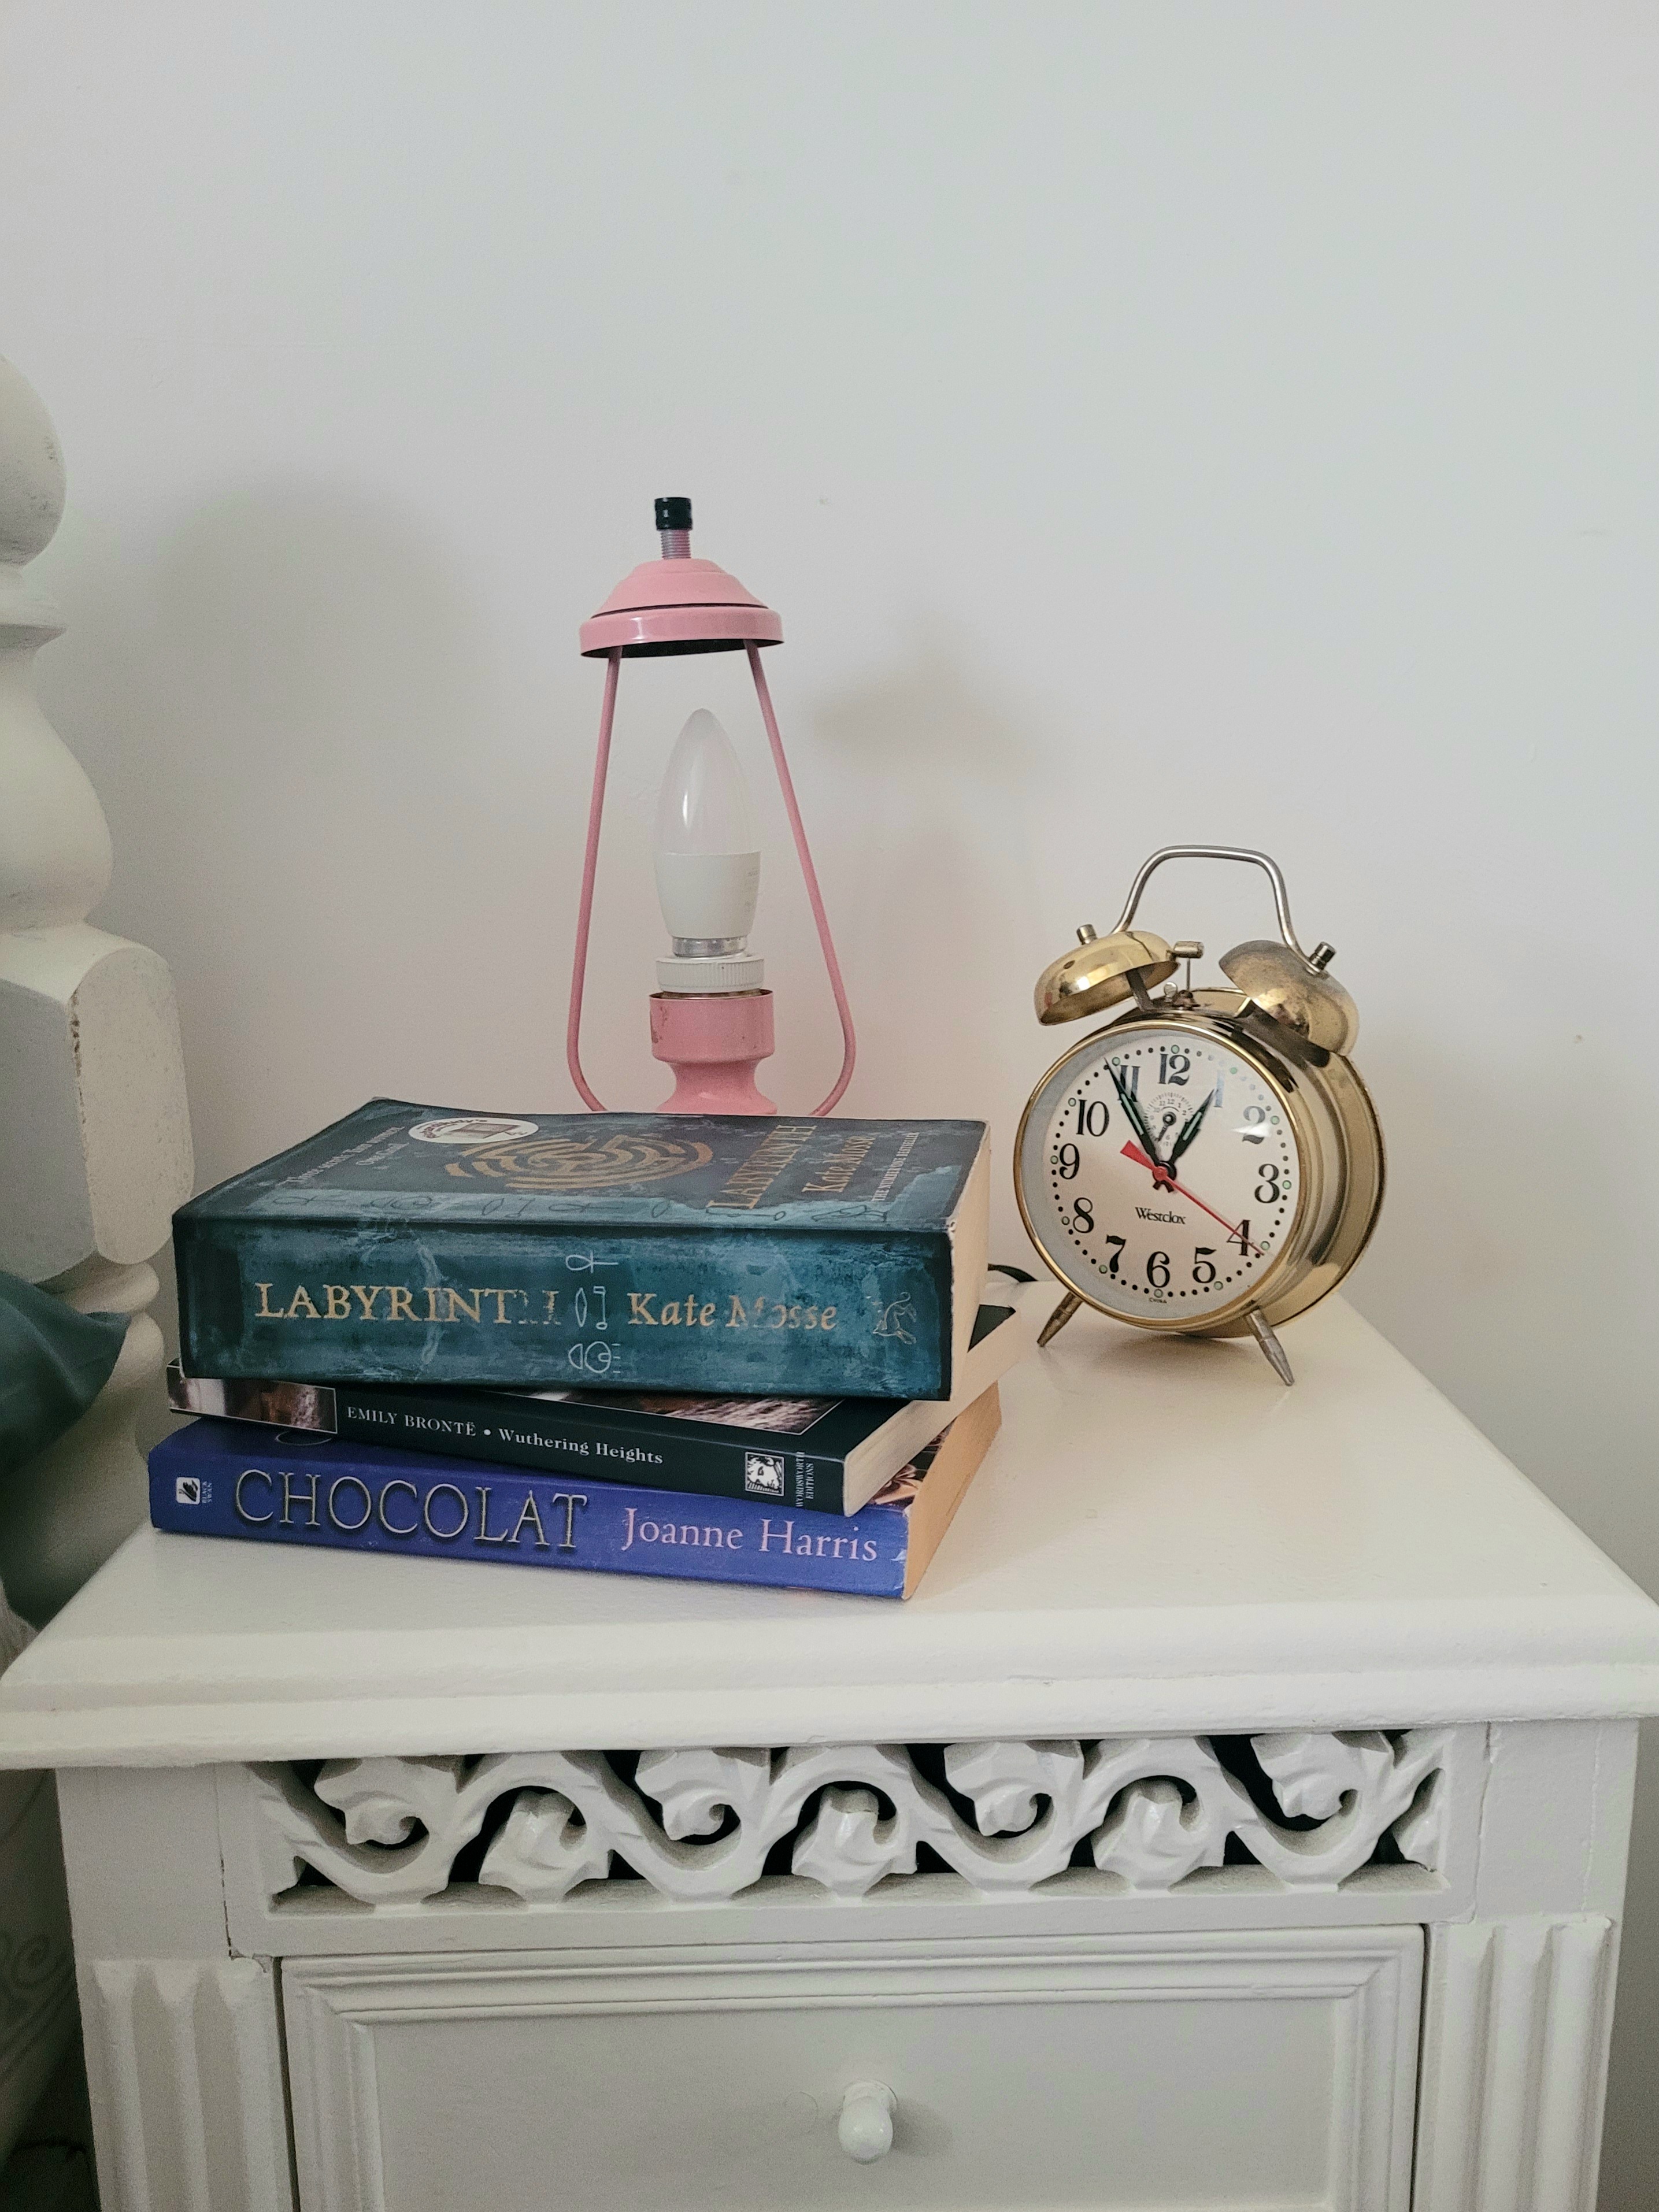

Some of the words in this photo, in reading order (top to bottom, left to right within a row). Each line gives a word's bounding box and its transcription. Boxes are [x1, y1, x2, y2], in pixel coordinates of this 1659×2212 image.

[1117, 1065, 1140, 1102] 11
[1158, 1053, 1191, 1086] 12
[1213, 1069, 1225, 1108] 1
[1076, 1099, 1110, 1137] 10
[1242, 1106, 1265, 1144] 2
[823, 1135, 876, 1164] Mosse
[890, 1157, 906, 1168] ONE
[896, 1132, 920, 1157] BESTSELLER
[1059, 1143, 1080, 1180] 9
[705, 1124, 818, 1209] LABYRINTH
[801, 1165, 857, 1193] Kate
[877, 1168, 902, 1189] NUMBER
[1254, 1164, 1280, 1203] 3
[871, 1189, 890, 1202] THE
[1072, 1197, 1094, 1233] 8
[1135, 1207, 1186, 1225] Westclox
[1106, 1235, 1126, 1273] 7
[1226, 1219, 1251, 1257] 4
[1146, 1251, 1171, 1288] 6
[1193, 1247, 1217, 1284] 5
[627, 1292, 716, 1327] Kate
[347, 1406, 398, 1425] EMILY
[405, 1414, 476, 1436] BRONTË
[498, 1428, 590, 1456] Wuthering
[596, 1442, 664, 1464] Heights
[795, 1451, 805, 1507] WORDSWORTH
[805, 1463, 814, 1499] EDITIONS
[235, 1468, 588, 1549] CHOCOLAT
[621, 1507, 743, 1552] Joanne
[758, 1518, 877, 1562] Harris
